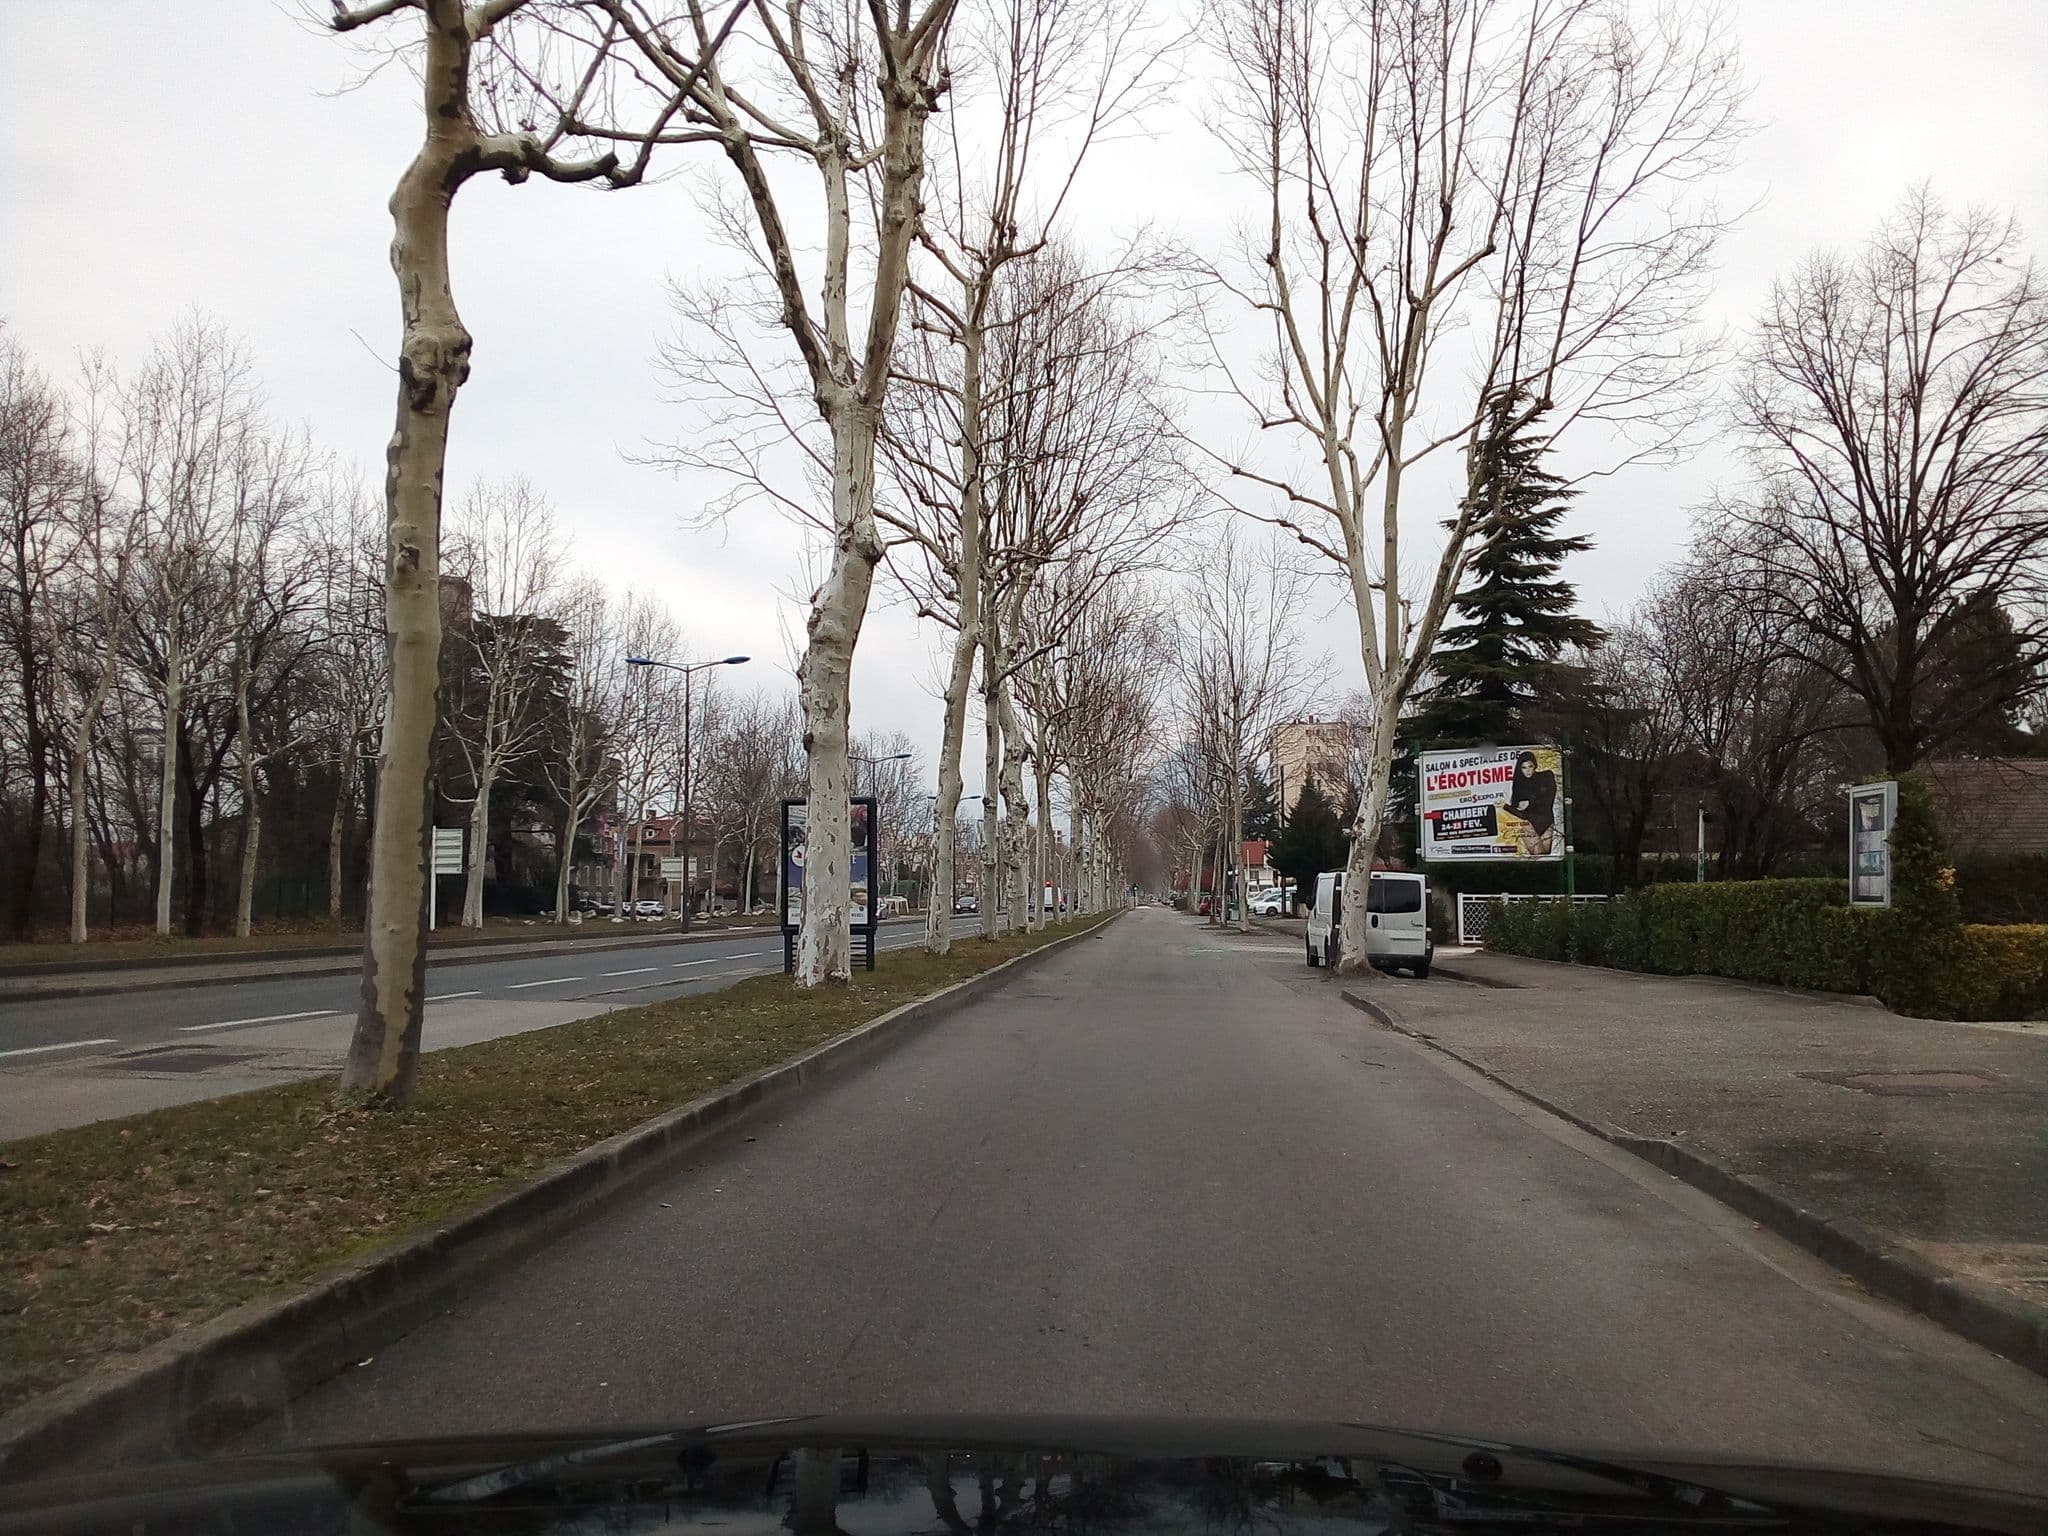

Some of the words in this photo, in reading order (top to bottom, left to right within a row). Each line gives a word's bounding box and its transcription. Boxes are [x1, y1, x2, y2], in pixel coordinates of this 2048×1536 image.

[1425, 760, 1450, 772] SALON
[1453, 759, 1458, 769] &
[1426, 765, 1513, 791] L'ÉROTISME
[1442, 805, 1489, 821] CHAMBERY
[1463, 818, 1483, 829] FEV.
